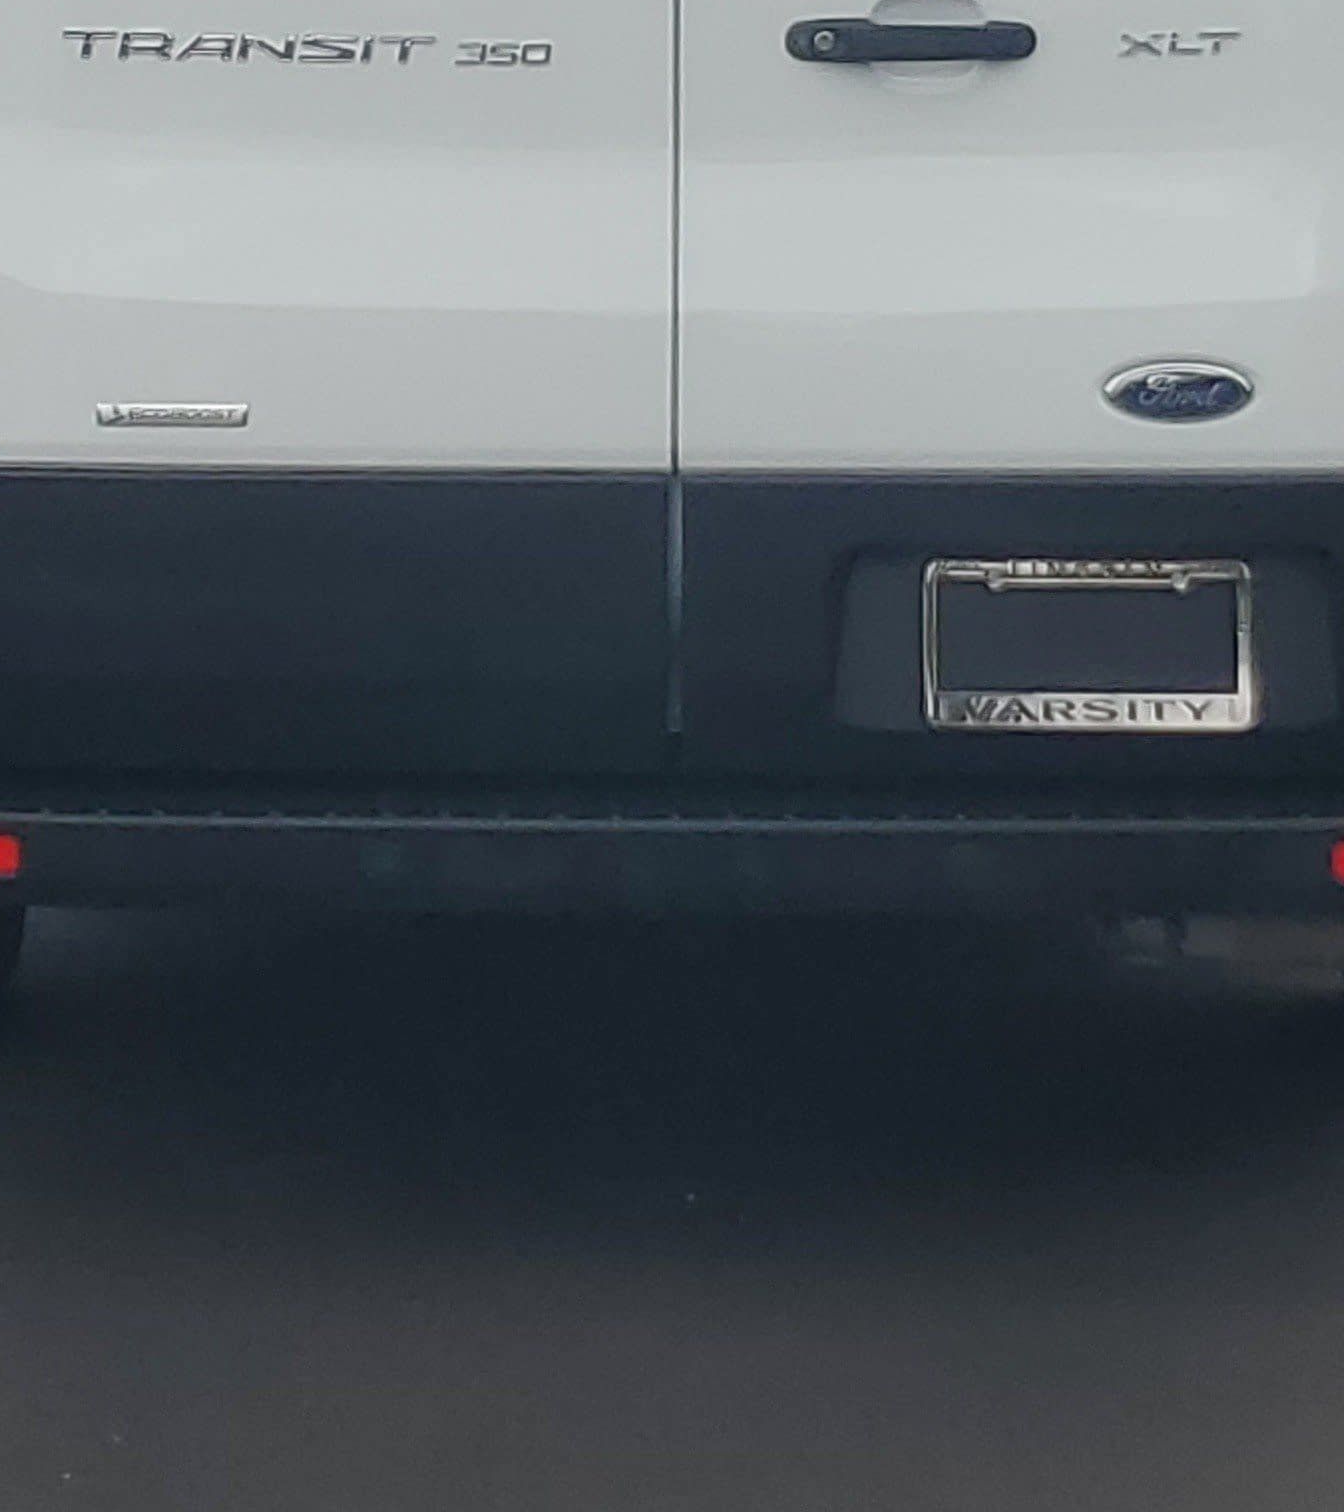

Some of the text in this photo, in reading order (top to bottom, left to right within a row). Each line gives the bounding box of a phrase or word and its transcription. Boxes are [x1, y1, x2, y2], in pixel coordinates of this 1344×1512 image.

[62, 30, 554, 66] TRANSIT 350
[1118, 31, 1243, 57] XLT
[962, 697, 1212, 723] VARSITY
